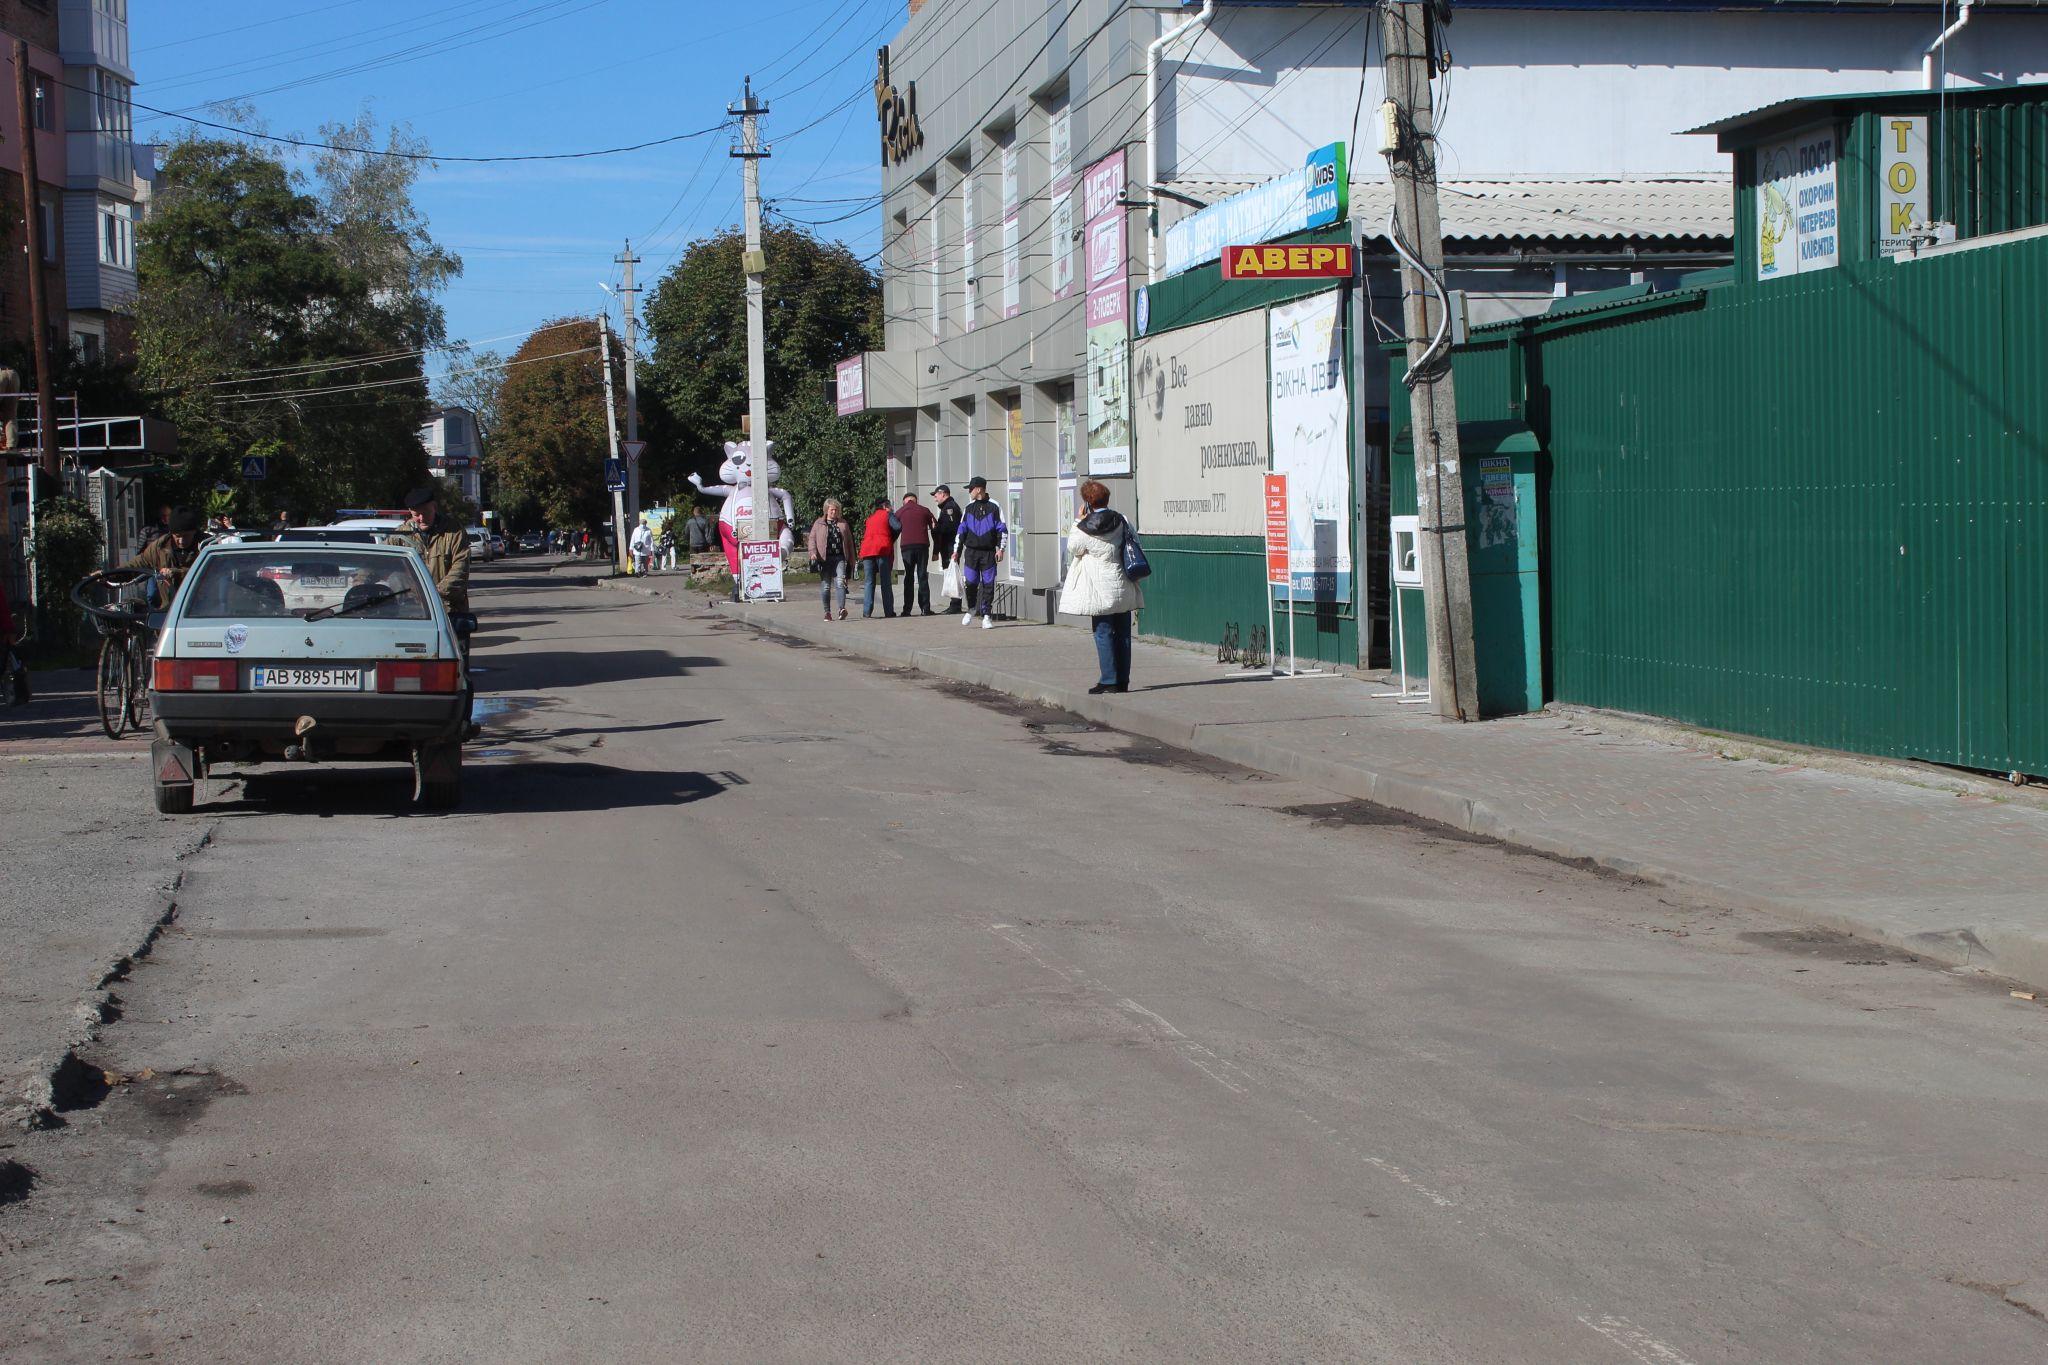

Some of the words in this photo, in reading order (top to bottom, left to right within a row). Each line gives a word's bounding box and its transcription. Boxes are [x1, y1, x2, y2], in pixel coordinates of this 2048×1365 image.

[1799, 140, 1831, 178] ПОСТ
[1315, 164, 1335, 188] WDS
[1888, 120, 1917, 235] ТОК
[1306, 190, 1337, 216] ВІКНА
[1799, 182, 1834, 208] ОХОРОНИ
[1798, 208, 1836, 234] ІНТЕРЕСІВ
[1235, 247, 1347, 275] ДВЕРІ
[1801, 235, 1835, 260] КЛІЄНТІВ
[1092, 291, 1122, 321] 2-ПОВЕРХ
[1170, 355, 1188, 389] Все
[1276, 367, 1308, 399] ВІКНА
[1184, 402, 1213, 431] давно
[1200, 440, 1267, 478] рознюхано...
[1482, 459, 1508, 467] ВІКНА
[744, 544, 777, 554] МЕБЛІ
[266, 670, 289, 685] AB
[292, 670, 330, 685] 9895
[333, 670, 357, 685] HM
